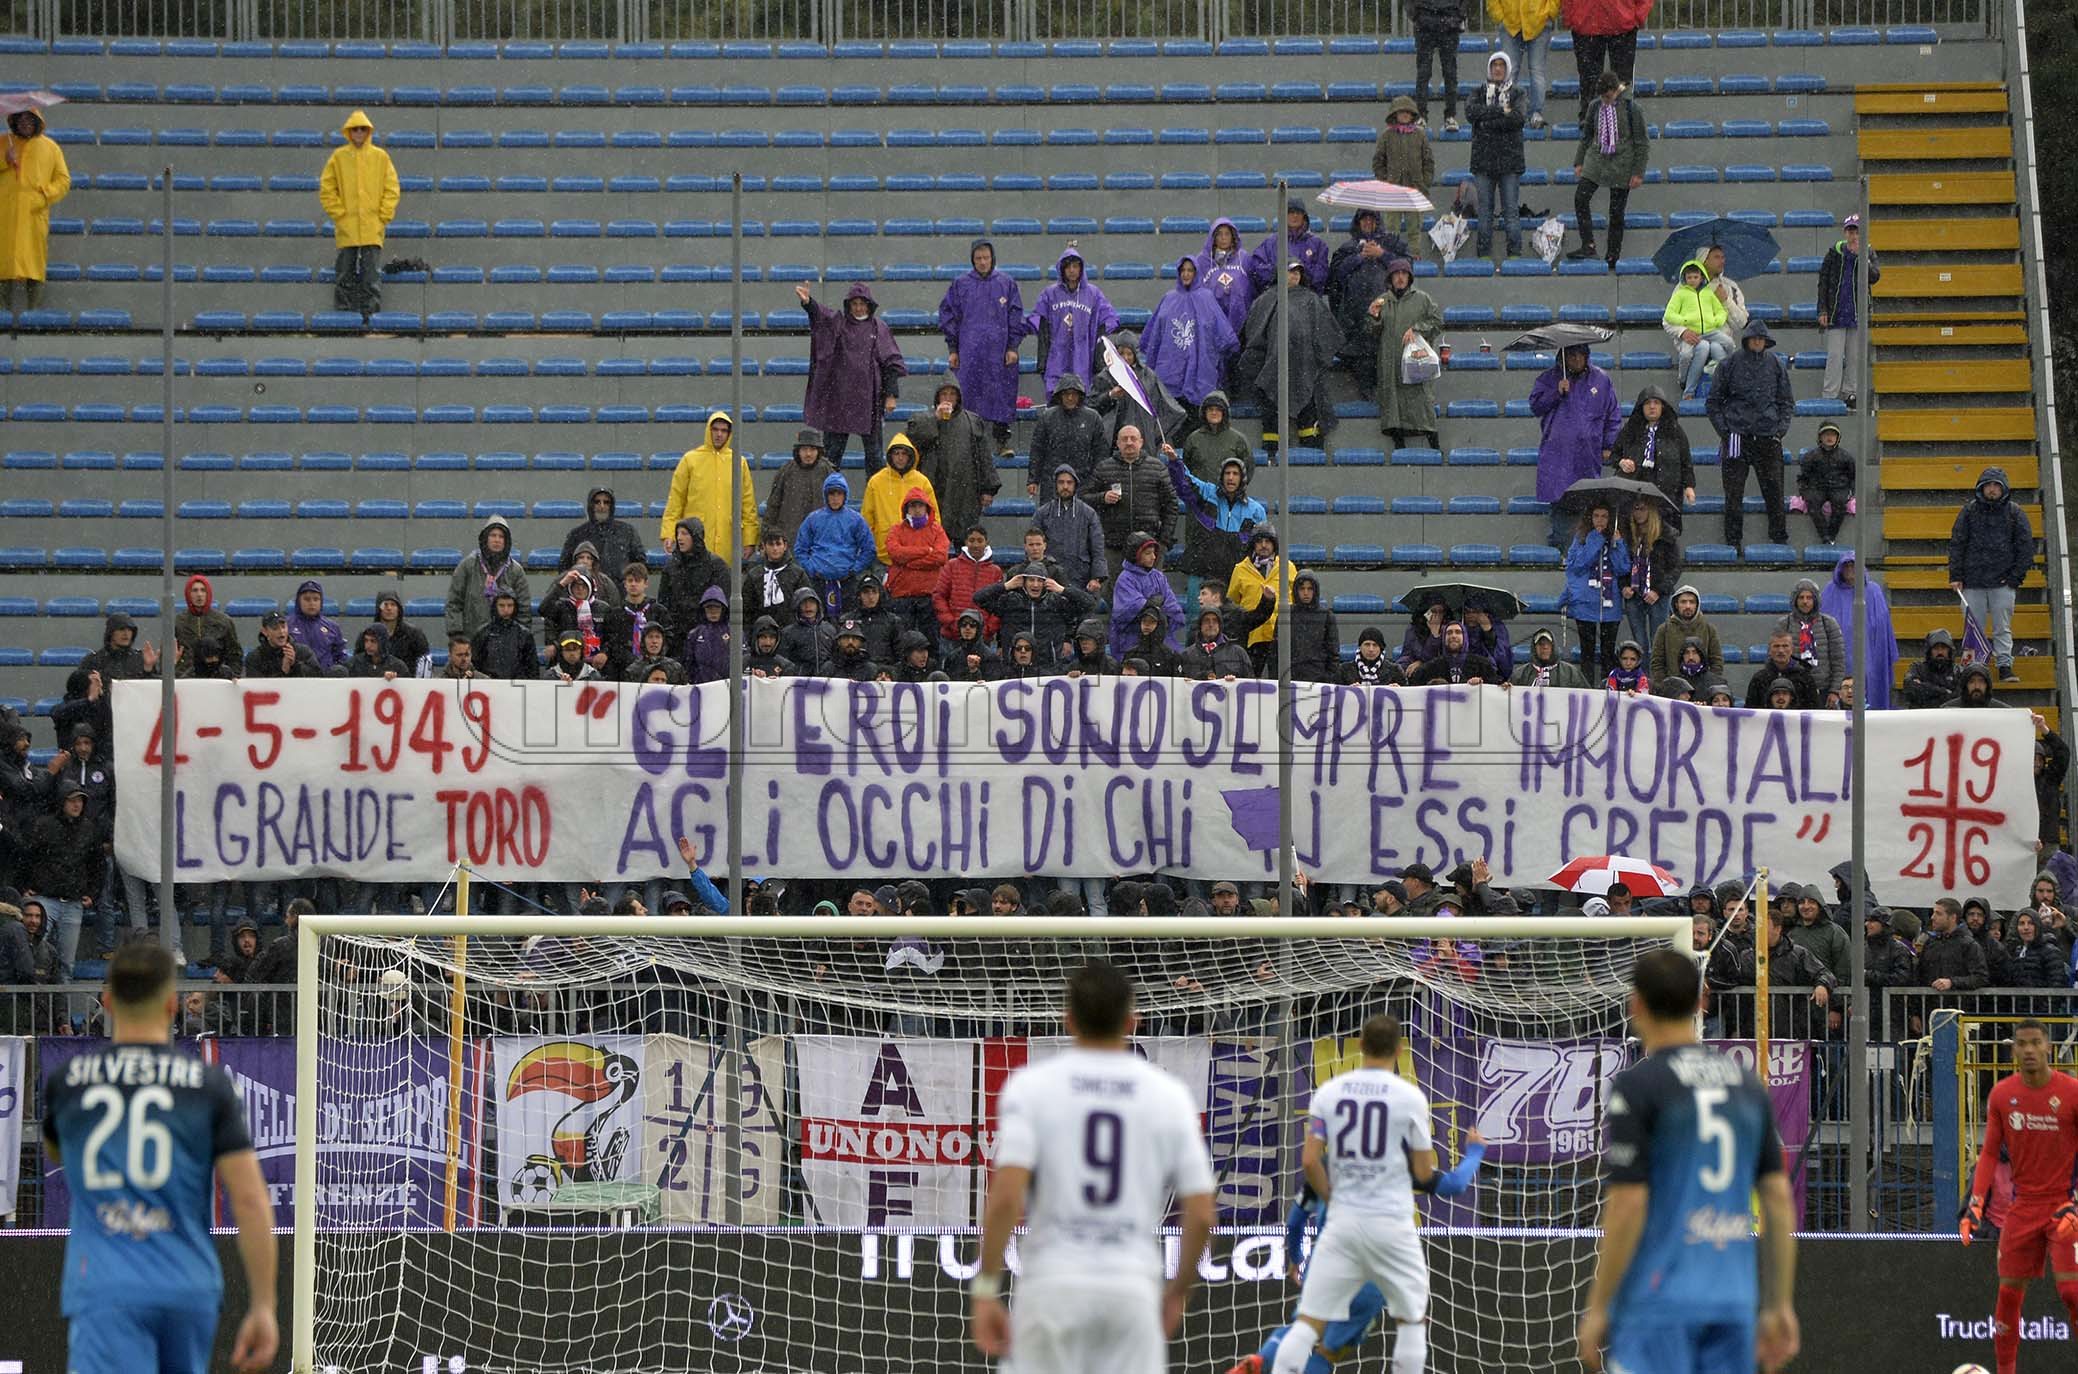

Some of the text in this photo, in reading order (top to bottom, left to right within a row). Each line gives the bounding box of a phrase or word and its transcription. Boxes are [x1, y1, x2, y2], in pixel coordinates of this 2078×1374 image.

[996, 678, 1167, 771] SONO
[1183, 680, 1468, 795] SEMPRE
[213, 781, 414, 868] GRANDE
[436, 786, 551, 867] TORO
[66, 1052, 204, 1088] SILVESTRE
[860, 1043, 925, 1117] A
[81, 1085, 175, 1191] 26
[808, 1123, 1002, 1163] UNONOV
[1081, 1110, 1124, 1206] 9
[1336, 1099, 1389, 1160] 20
[1694, 1088, 1737, 1193] 5
[2019, 1315, 2070, 1340] talia
